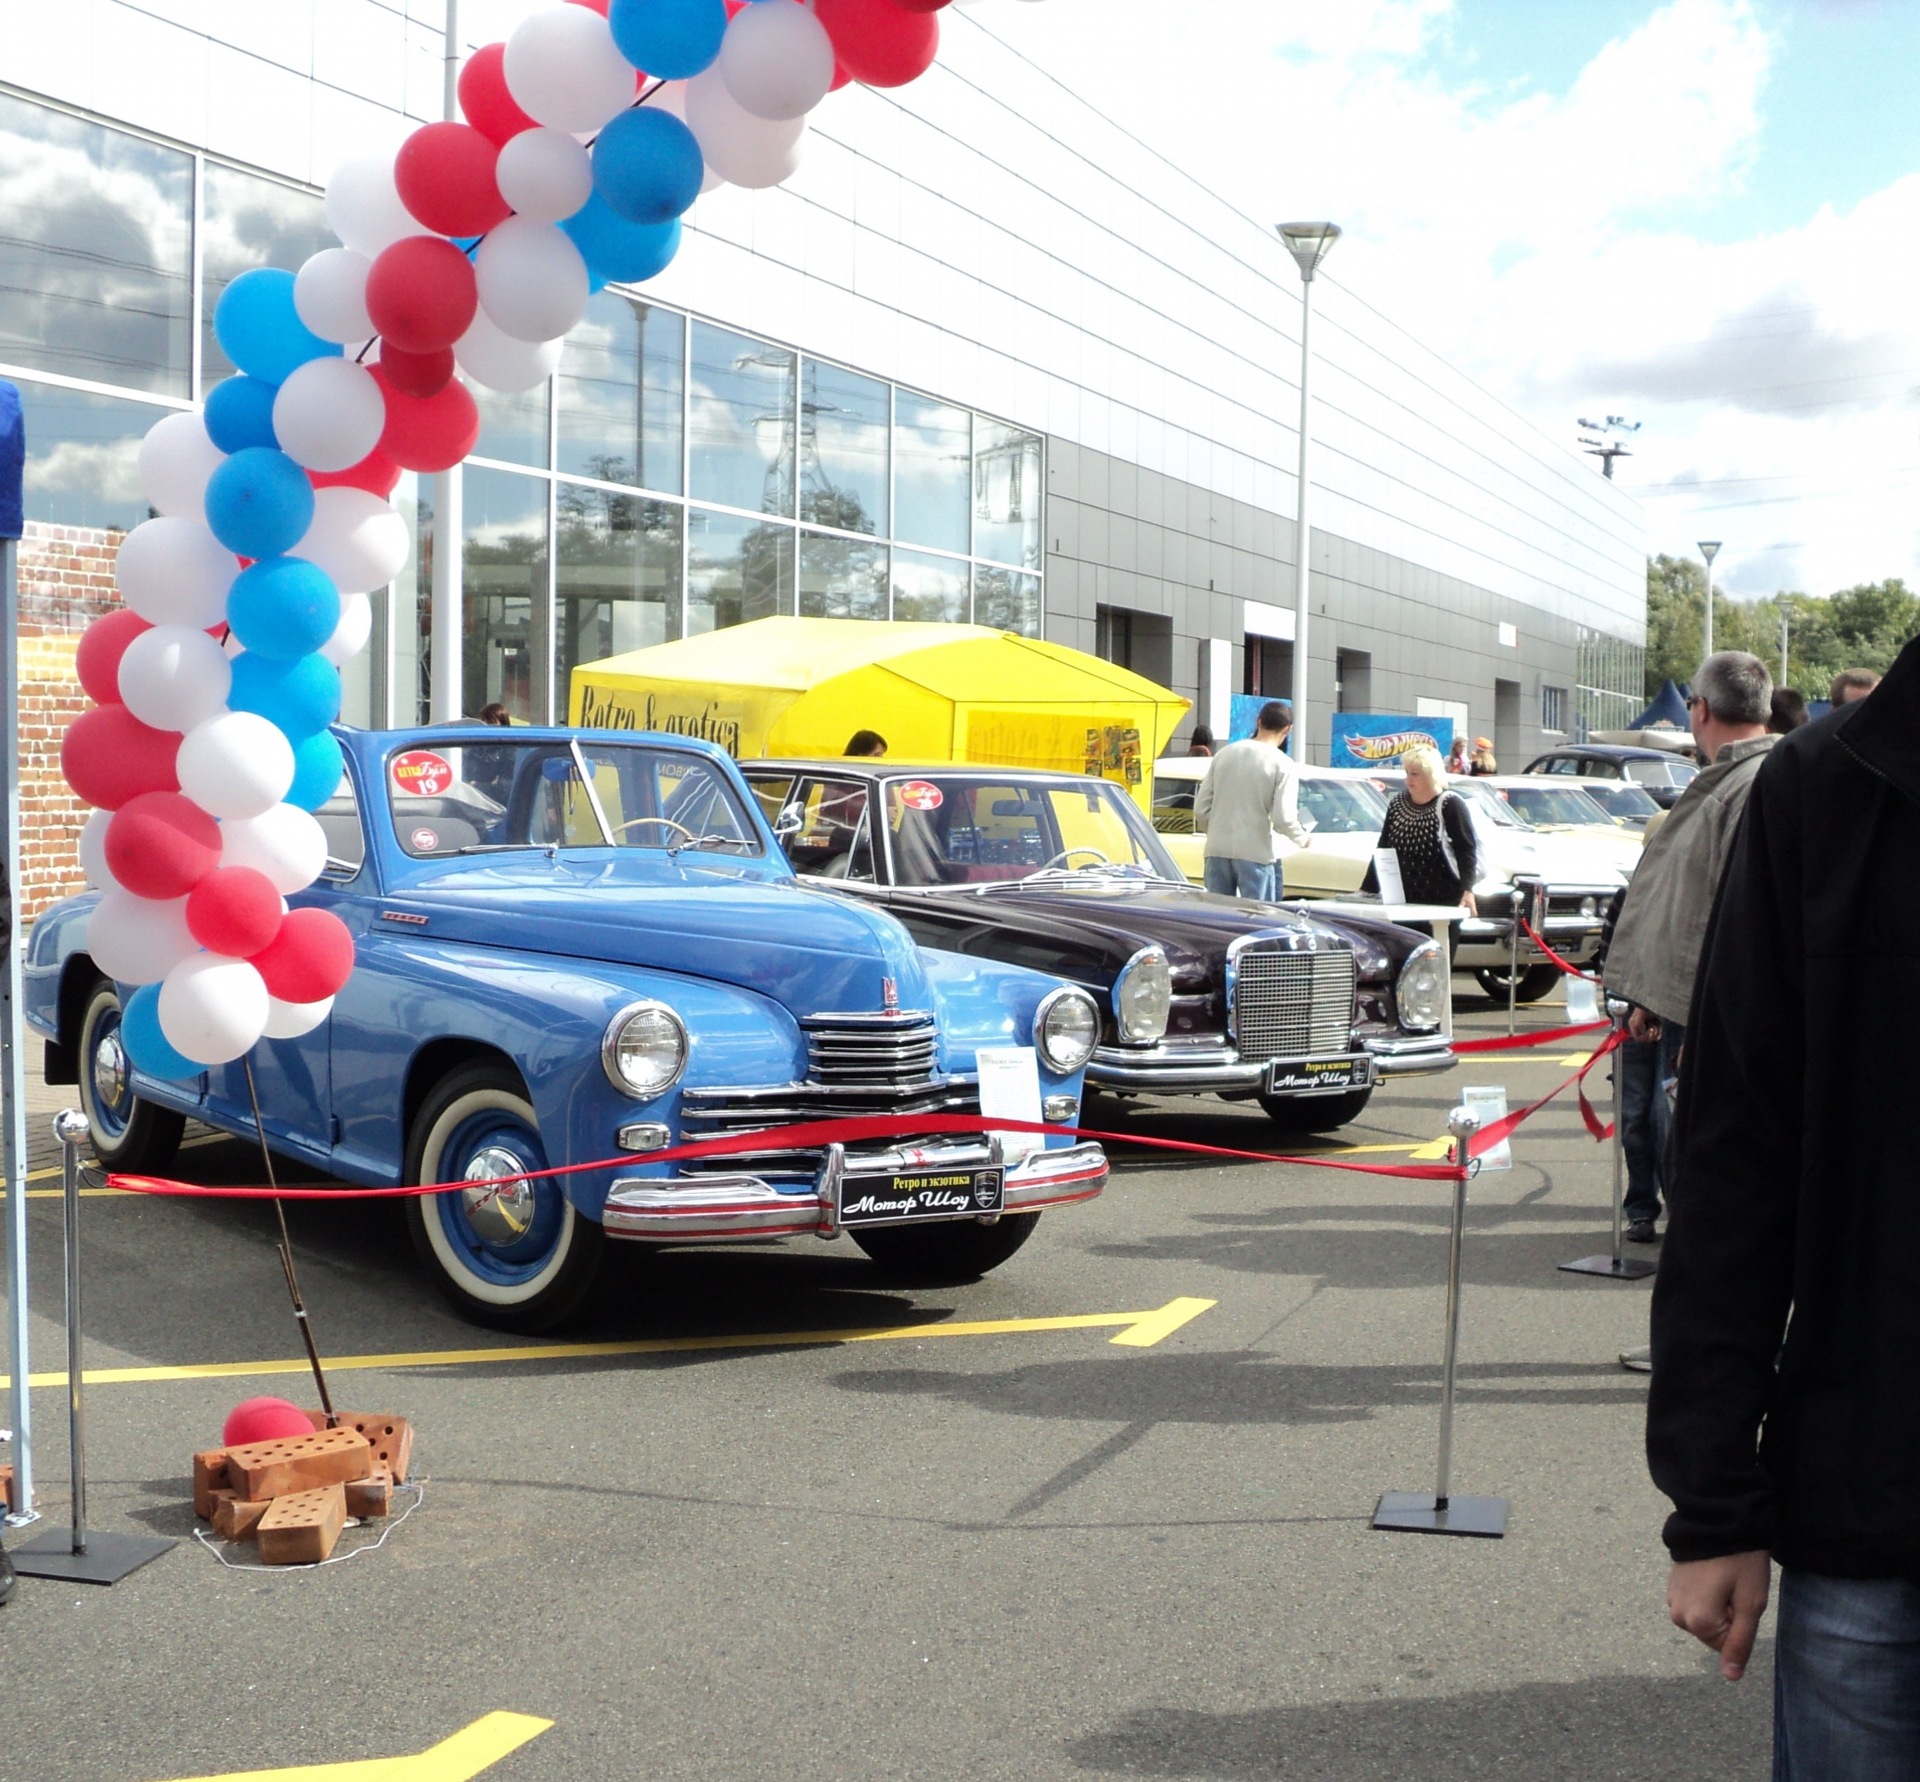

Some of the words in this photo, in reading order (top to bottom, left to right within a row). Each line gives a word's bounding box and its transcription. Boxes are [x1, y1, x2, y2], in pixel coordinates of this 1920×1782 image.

[417, 779, 438, 795] 19
[1274, 1074, 1320, 1088] Мотор
[1320, 1072, 1351, 1086] Шоу
[893, 1177, 920, 1191] Ретро
[921, 1178, 928, 1188] и
[929, 1175, 970, 1188] экзотика
[843, 1195, 917, 1215] Мотор
[919, 1191, 970, 1211] Шоу
